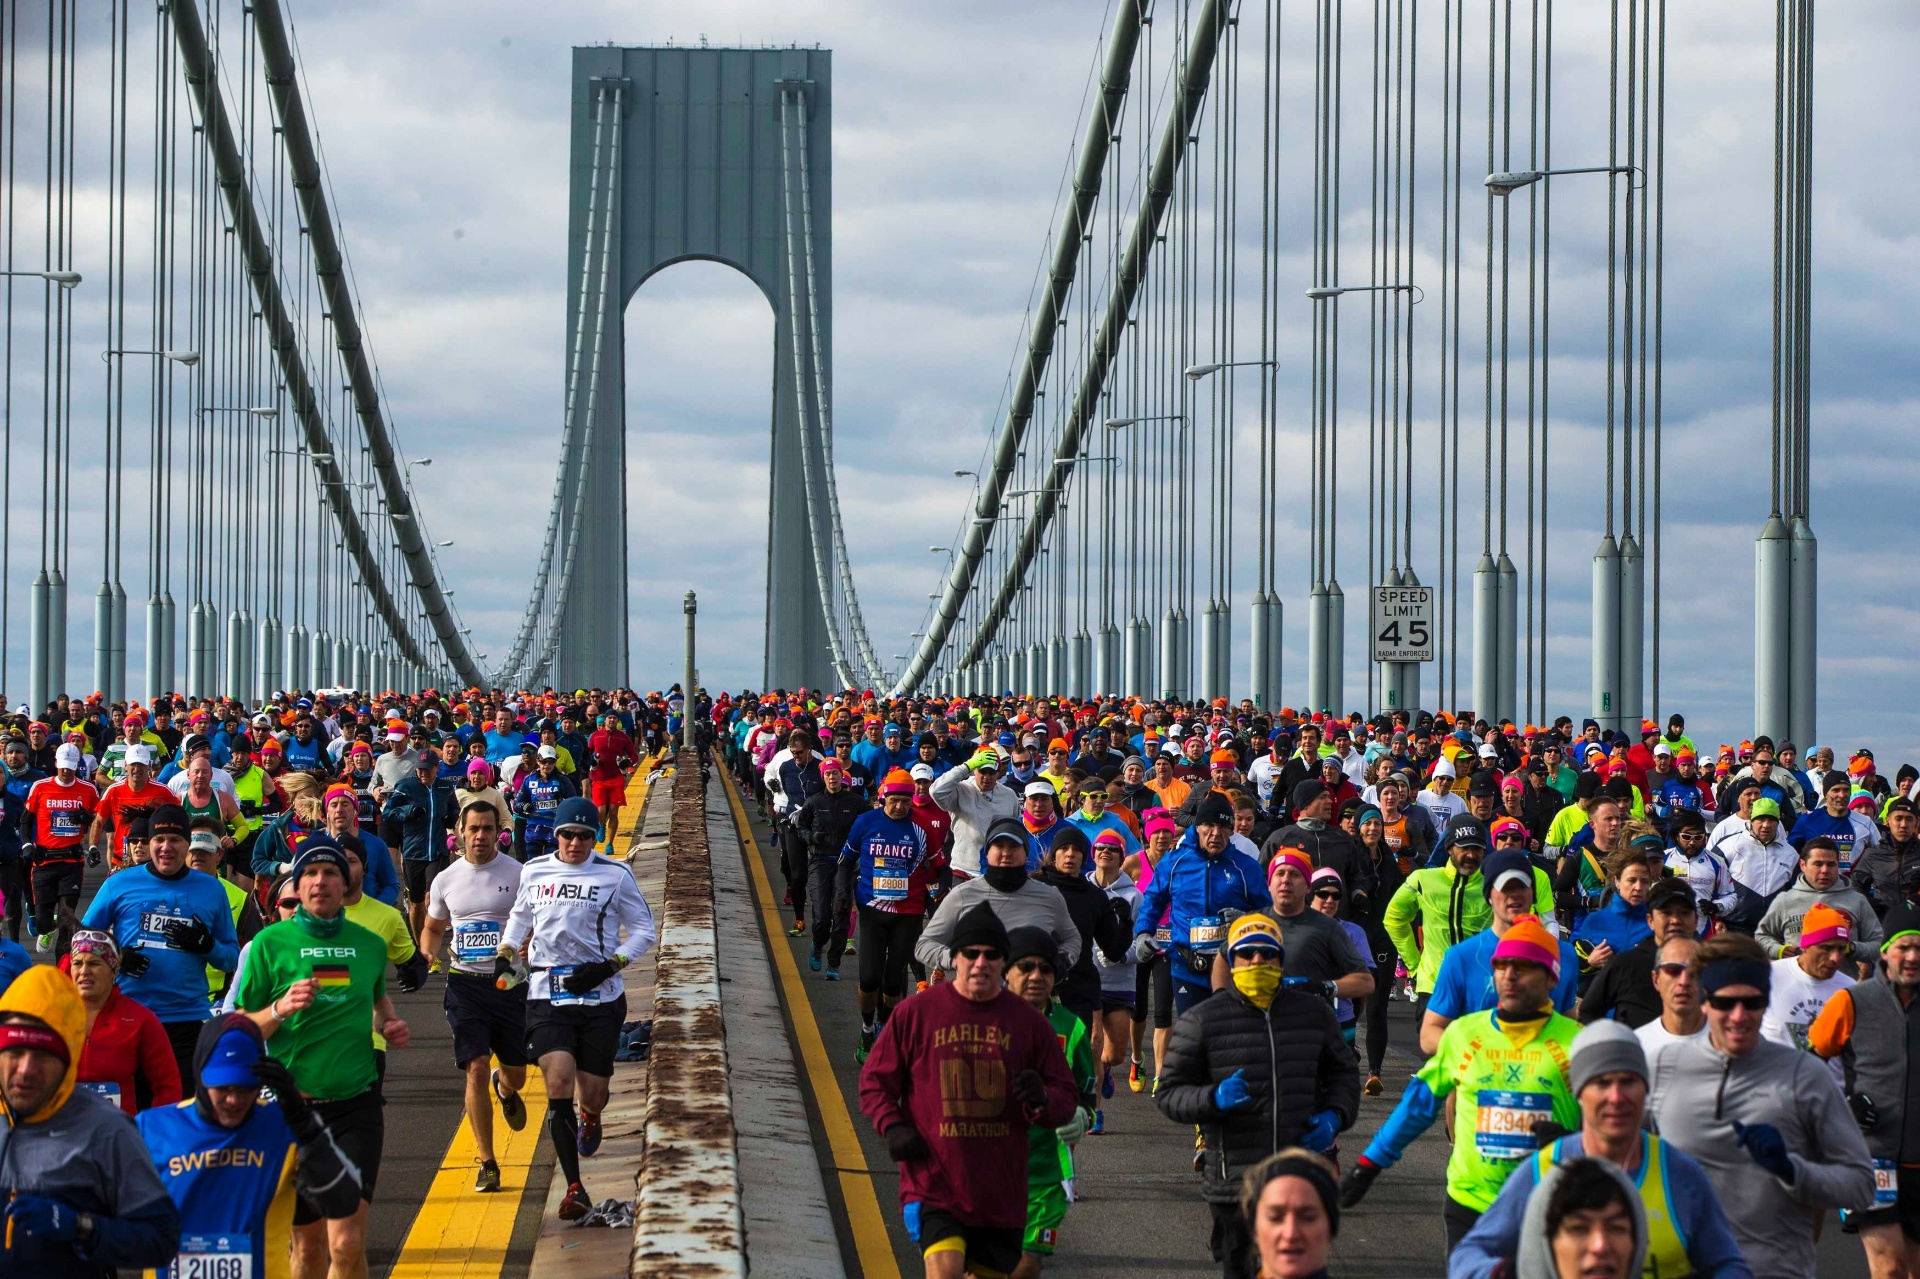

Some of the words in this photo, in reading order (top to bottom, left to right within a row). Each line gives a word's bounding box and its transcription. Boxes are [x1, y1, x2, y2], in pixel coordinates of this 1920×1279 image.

[1379, 591, 1428, 603] SPEED
[1384, 606, 1422, 616] LIMIT
[1378, 621, 1429, 646] 45
[532, 786, 559, 795] ERIKA
[1455, 826, 1477, 839] NYC
[869, 843, 913, 858] FRANCE
[882, 878, 906, 889] 29081
[557, 884, 600, 902] ABLE
[554, 900, 598, 910] foundation
[1239, 923, 1265, 937] NEW
[466, 933, 498, 948] 22206
[301, 947, 357, 959] PETER
[1790, 1000, 1805, 1016] NEW
[935, 1023, 1012, 1051] HARLEM
[939, 1122, 1011, 1137] MARATHON
[168, 1148, 265, 1177] SWEDEN
[189, 1257, 243, 1279] 21168
